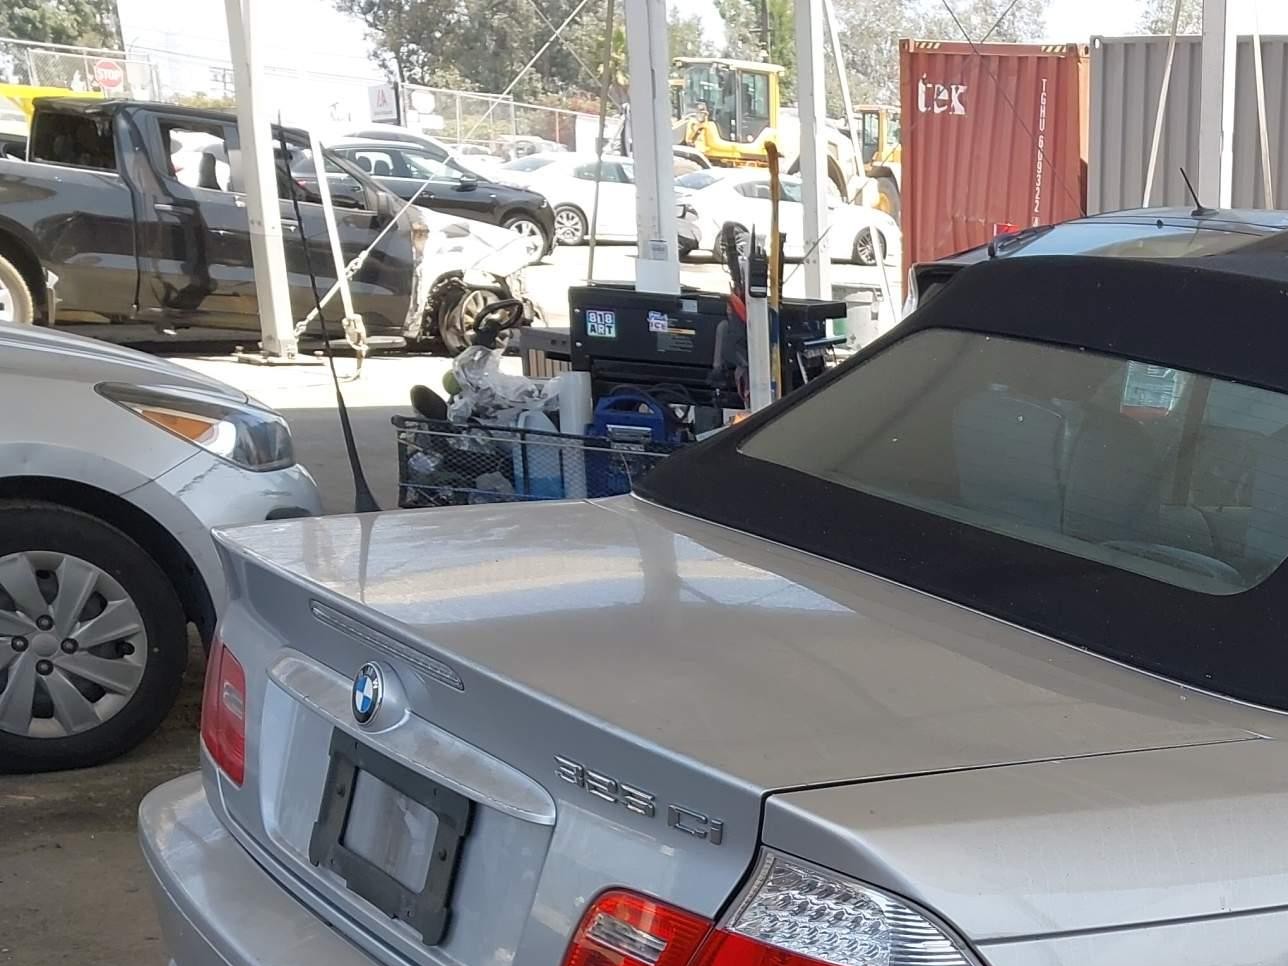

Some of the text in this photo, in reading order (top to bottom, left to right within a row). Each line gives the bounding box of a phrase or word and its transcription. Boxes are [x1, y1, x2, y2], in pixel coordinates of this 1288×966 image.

[96, 69, 122, 81] STOP
[1039, 79, 1047, 132] TGHU
[588, 311, 614, 324] 818
[588, 324, 615, 336] ART
[553, 753, 656, 818] 325
